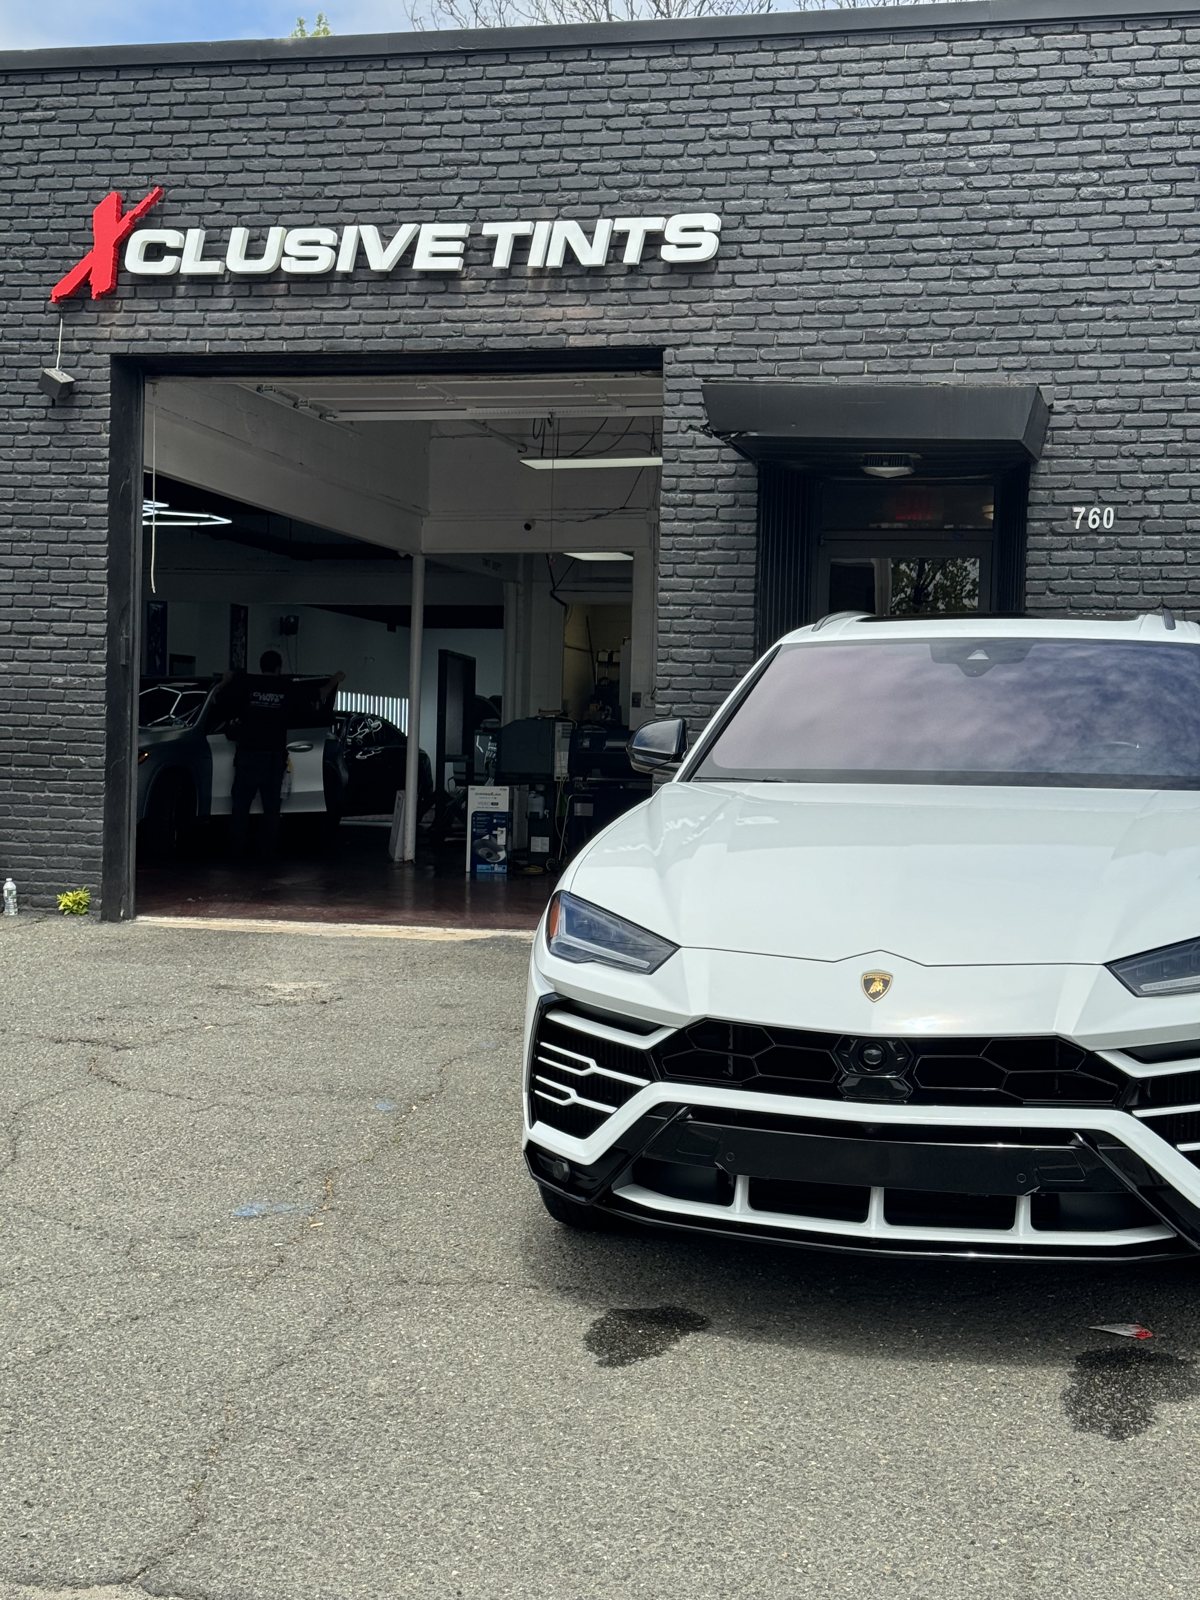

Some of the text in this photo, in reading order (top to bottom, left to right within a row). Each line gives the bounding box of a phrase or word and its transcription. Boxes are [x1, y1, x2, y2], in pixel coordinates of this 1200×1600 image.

[50, 187, 721, 303] XCLUSIVE TINTS
[1073, 507, 1115, 530] 760
